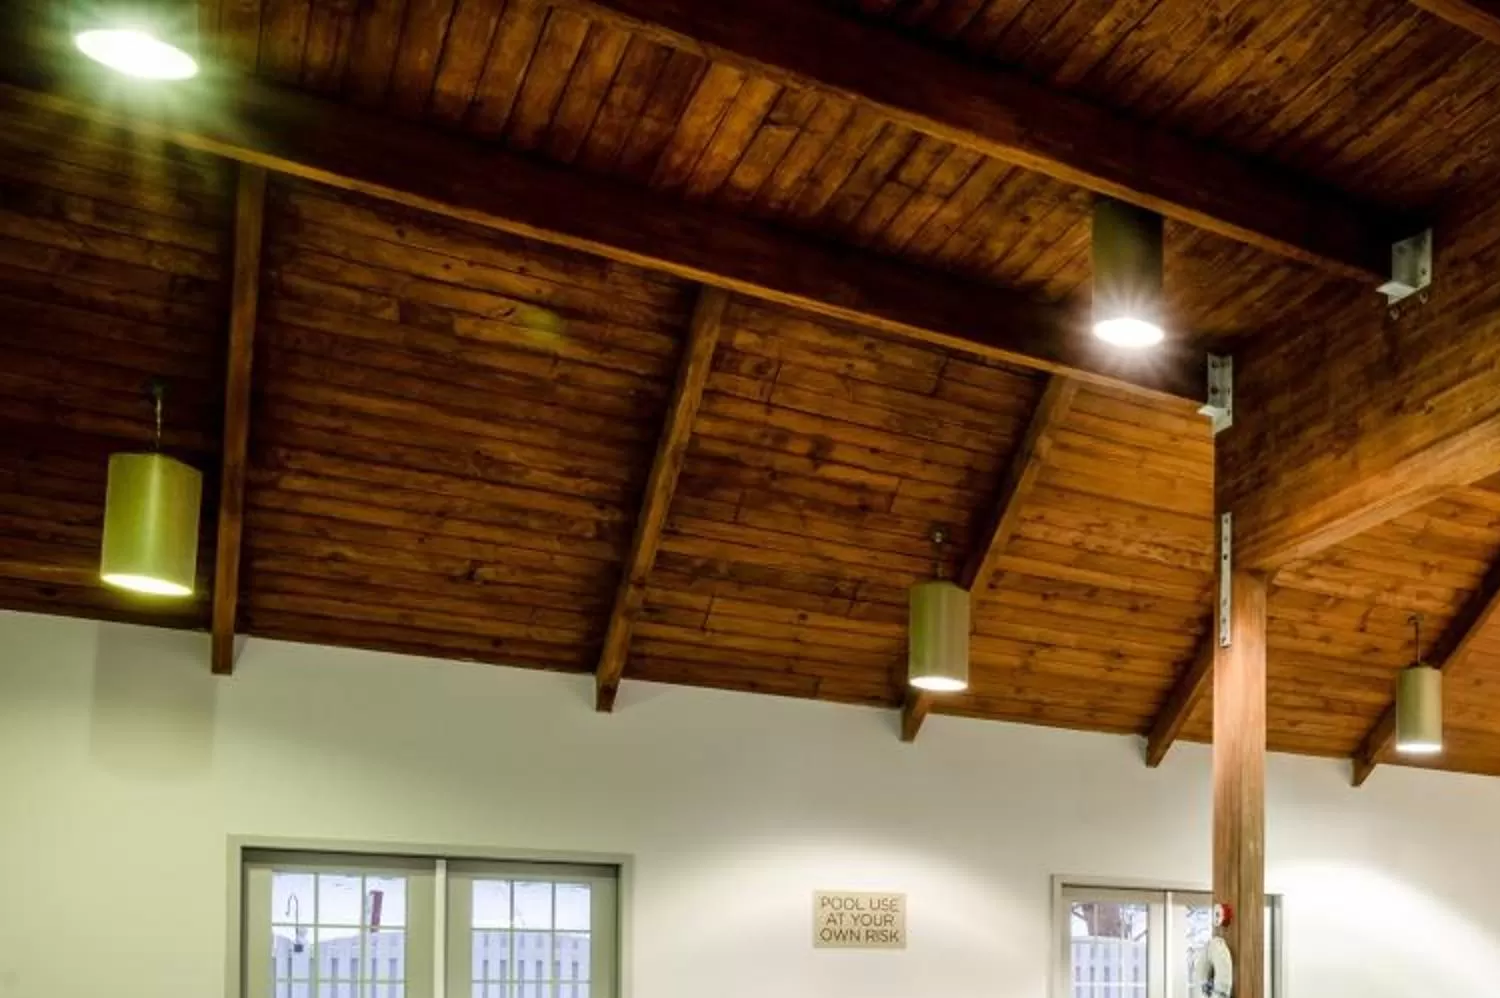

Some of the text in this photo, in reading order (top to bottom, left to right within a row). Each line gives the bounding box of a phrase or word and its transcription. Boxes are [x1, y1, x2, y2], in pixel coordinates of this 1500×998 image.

[820, 896, 900, 912] POOL USE
[826, 912, 895, 927] AT YOUR
[819, 928, 900, 943] OWN RISK
